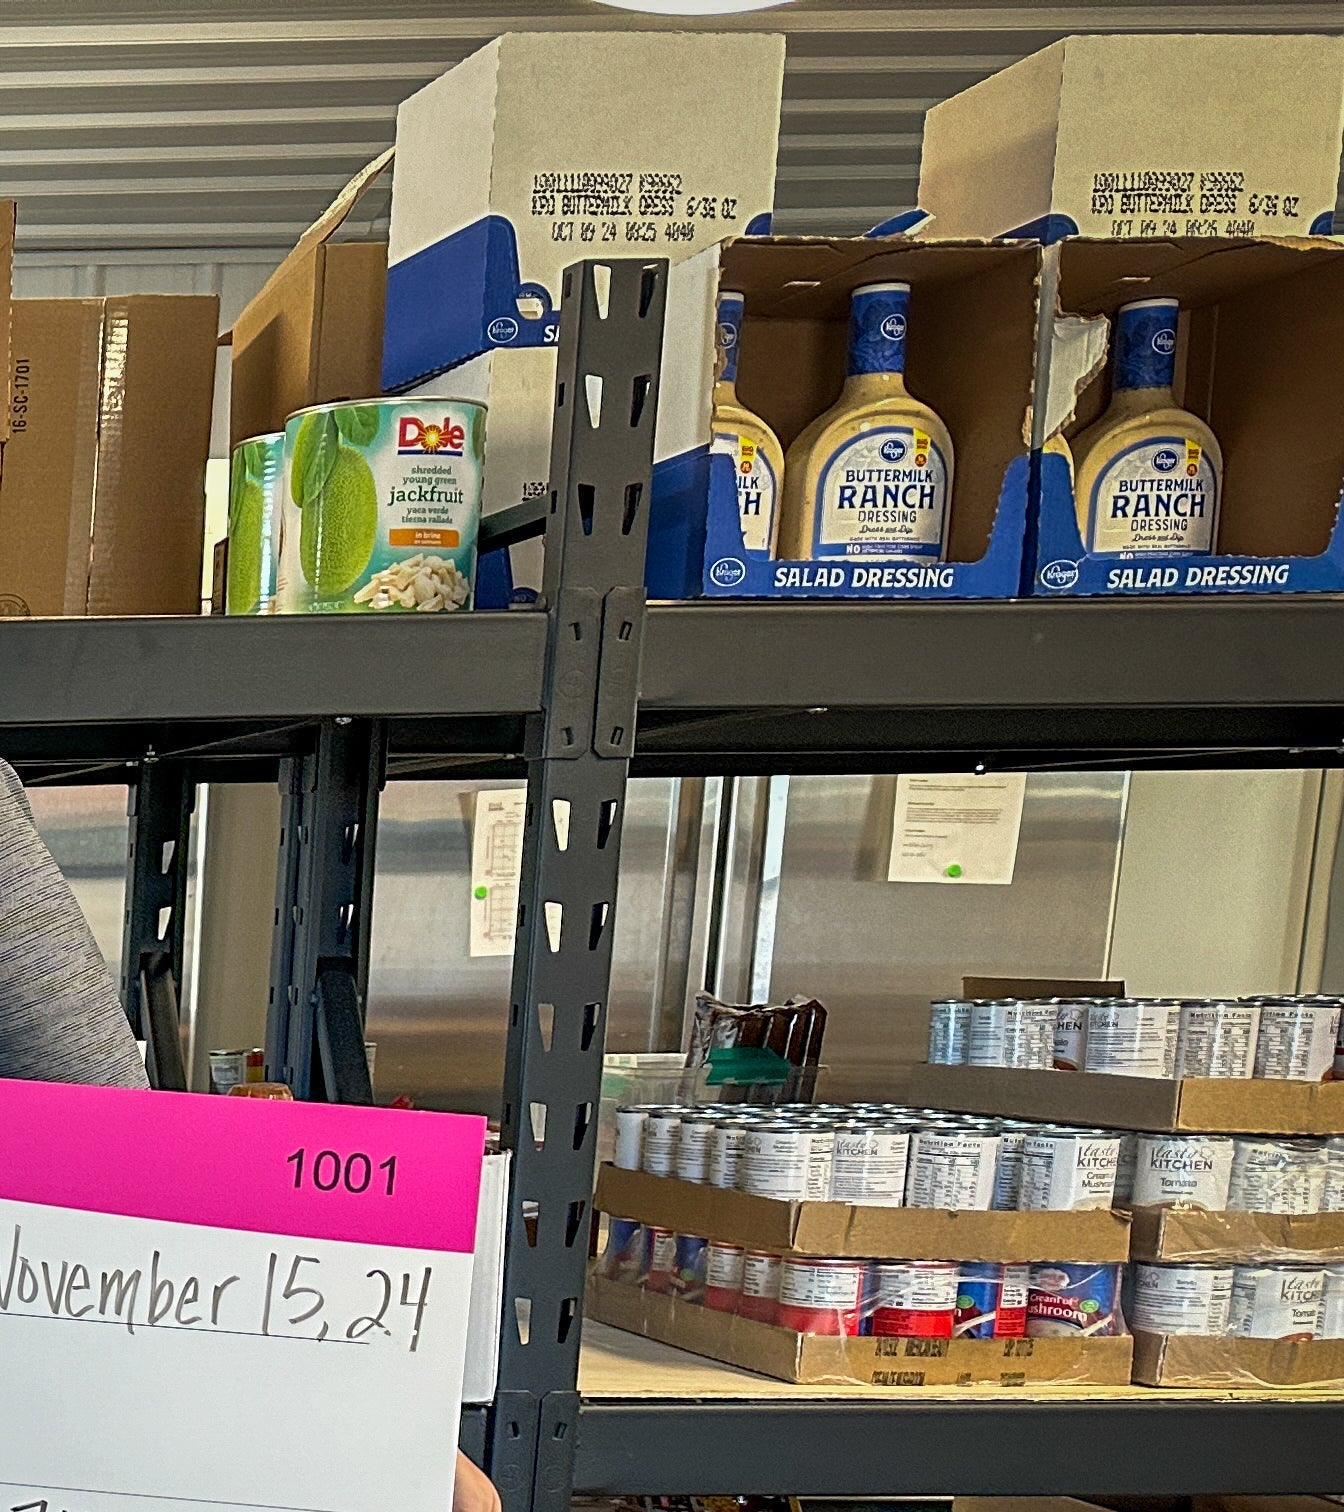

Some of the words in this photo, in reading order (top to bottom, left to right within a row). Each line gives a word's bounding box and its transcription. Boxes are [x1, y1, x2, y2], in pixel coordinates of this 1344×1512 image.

[12, 358, 31, 434] 16-SC-1701
[398, 416, 465, 451] Dole
[845, 469, 934, 483] BUTTERMILK
[1118, 479, 1204, 493] BUTTERMILK
[387, 485, 464, 506] jackfruit
[837, 484, 936, 509] RANCH
[1110, 493, 1206, 518] RANCH
[858, 510, 917, 523] DRESSING
[1130, 519, 1188, 531] DRESSING
[774, 566, 846, 588] SALAD
[851, 566, 955, 588] DRESSING
[1107, 567, 1179, 588] SALAD
[1185, 565, 1290, 587] DRESSING
[287, 1147, 398, 1195] 1001
[1150, 1158, 1213, 1171] KITCHEN
[346, 1267, 433, 1352] 24
